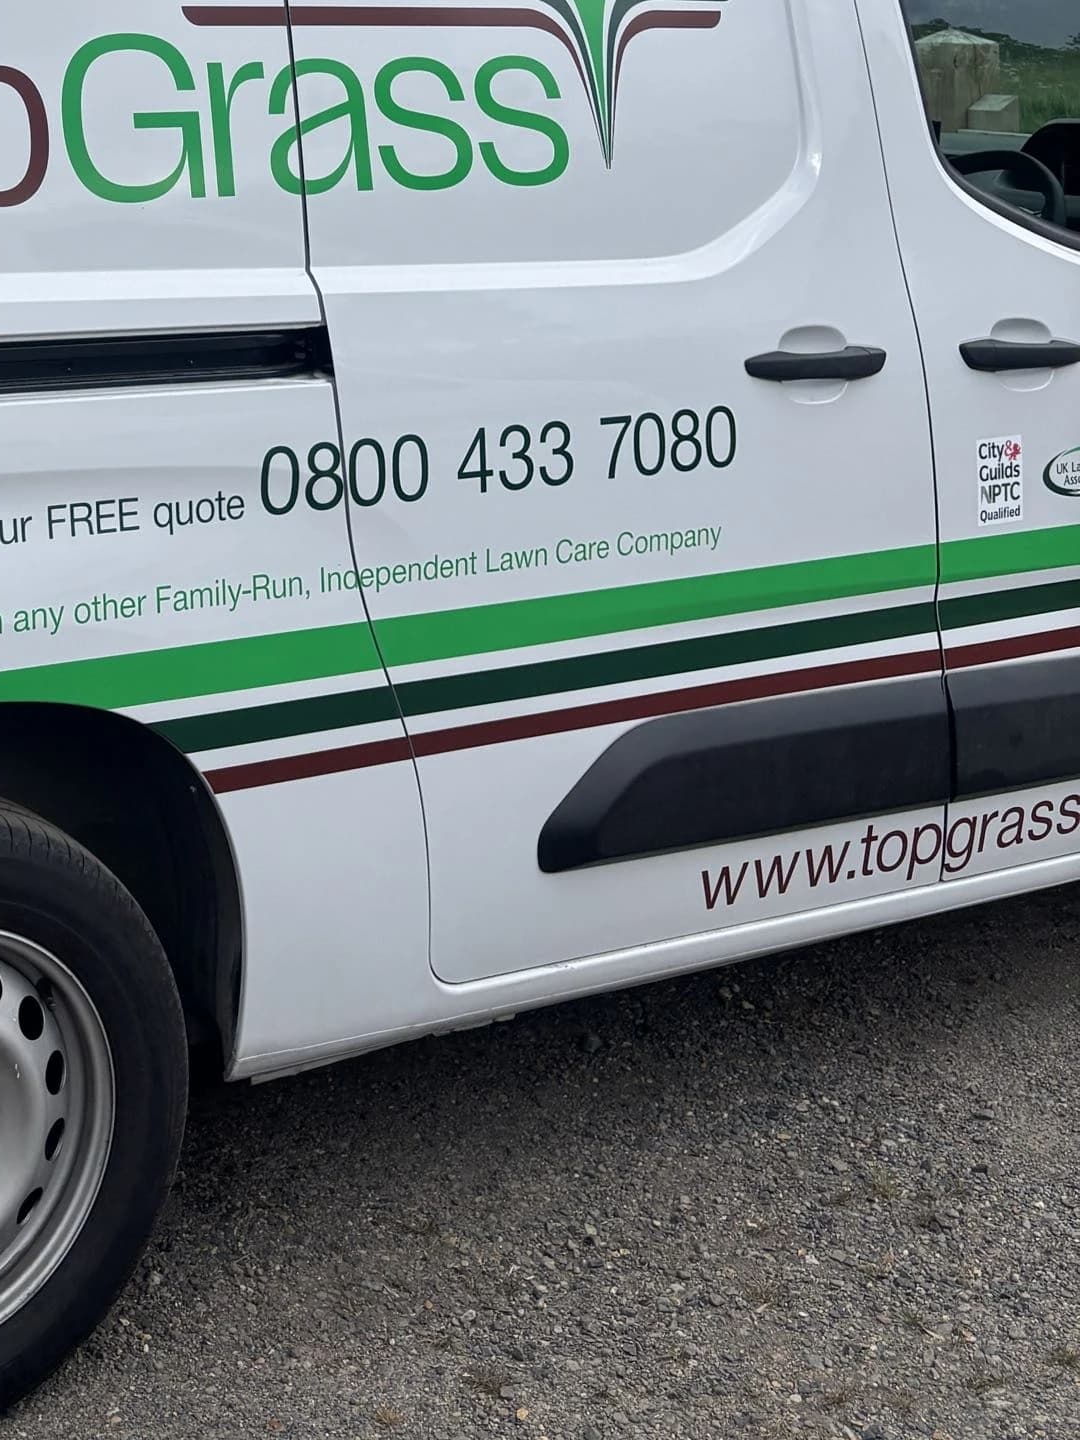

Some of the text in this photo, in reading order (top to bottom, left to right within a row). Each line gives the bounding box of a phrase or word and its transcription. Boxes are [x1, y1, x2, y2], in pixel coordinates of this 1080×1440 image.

[47, 497, 140, 540] FREE
[153, 490, 245, 535] quote
[260, 434, 429, 515] 0800
[457, 420, 574, 493] 433
[600, 405, 737, 479] 7080
[979, 461, 1020, 482] Guilds
[1056, 462, 1068, 474] UK
[981, 481, 1020, 504] NPTC
[980, 505, 1020, 523] Qualified
[13, 605, 64, 635] any
[74, 593, 147, 625] other
[155, 573, 311, 613] Family-Run,
[320, 551, 478, 593] Independent
[486, 548, 548, 573] Lawn
[555, 539, 610, 564] Care
[617, 526, 722, 556] Company
[701, 794, 1080, 910] www.topgrass
